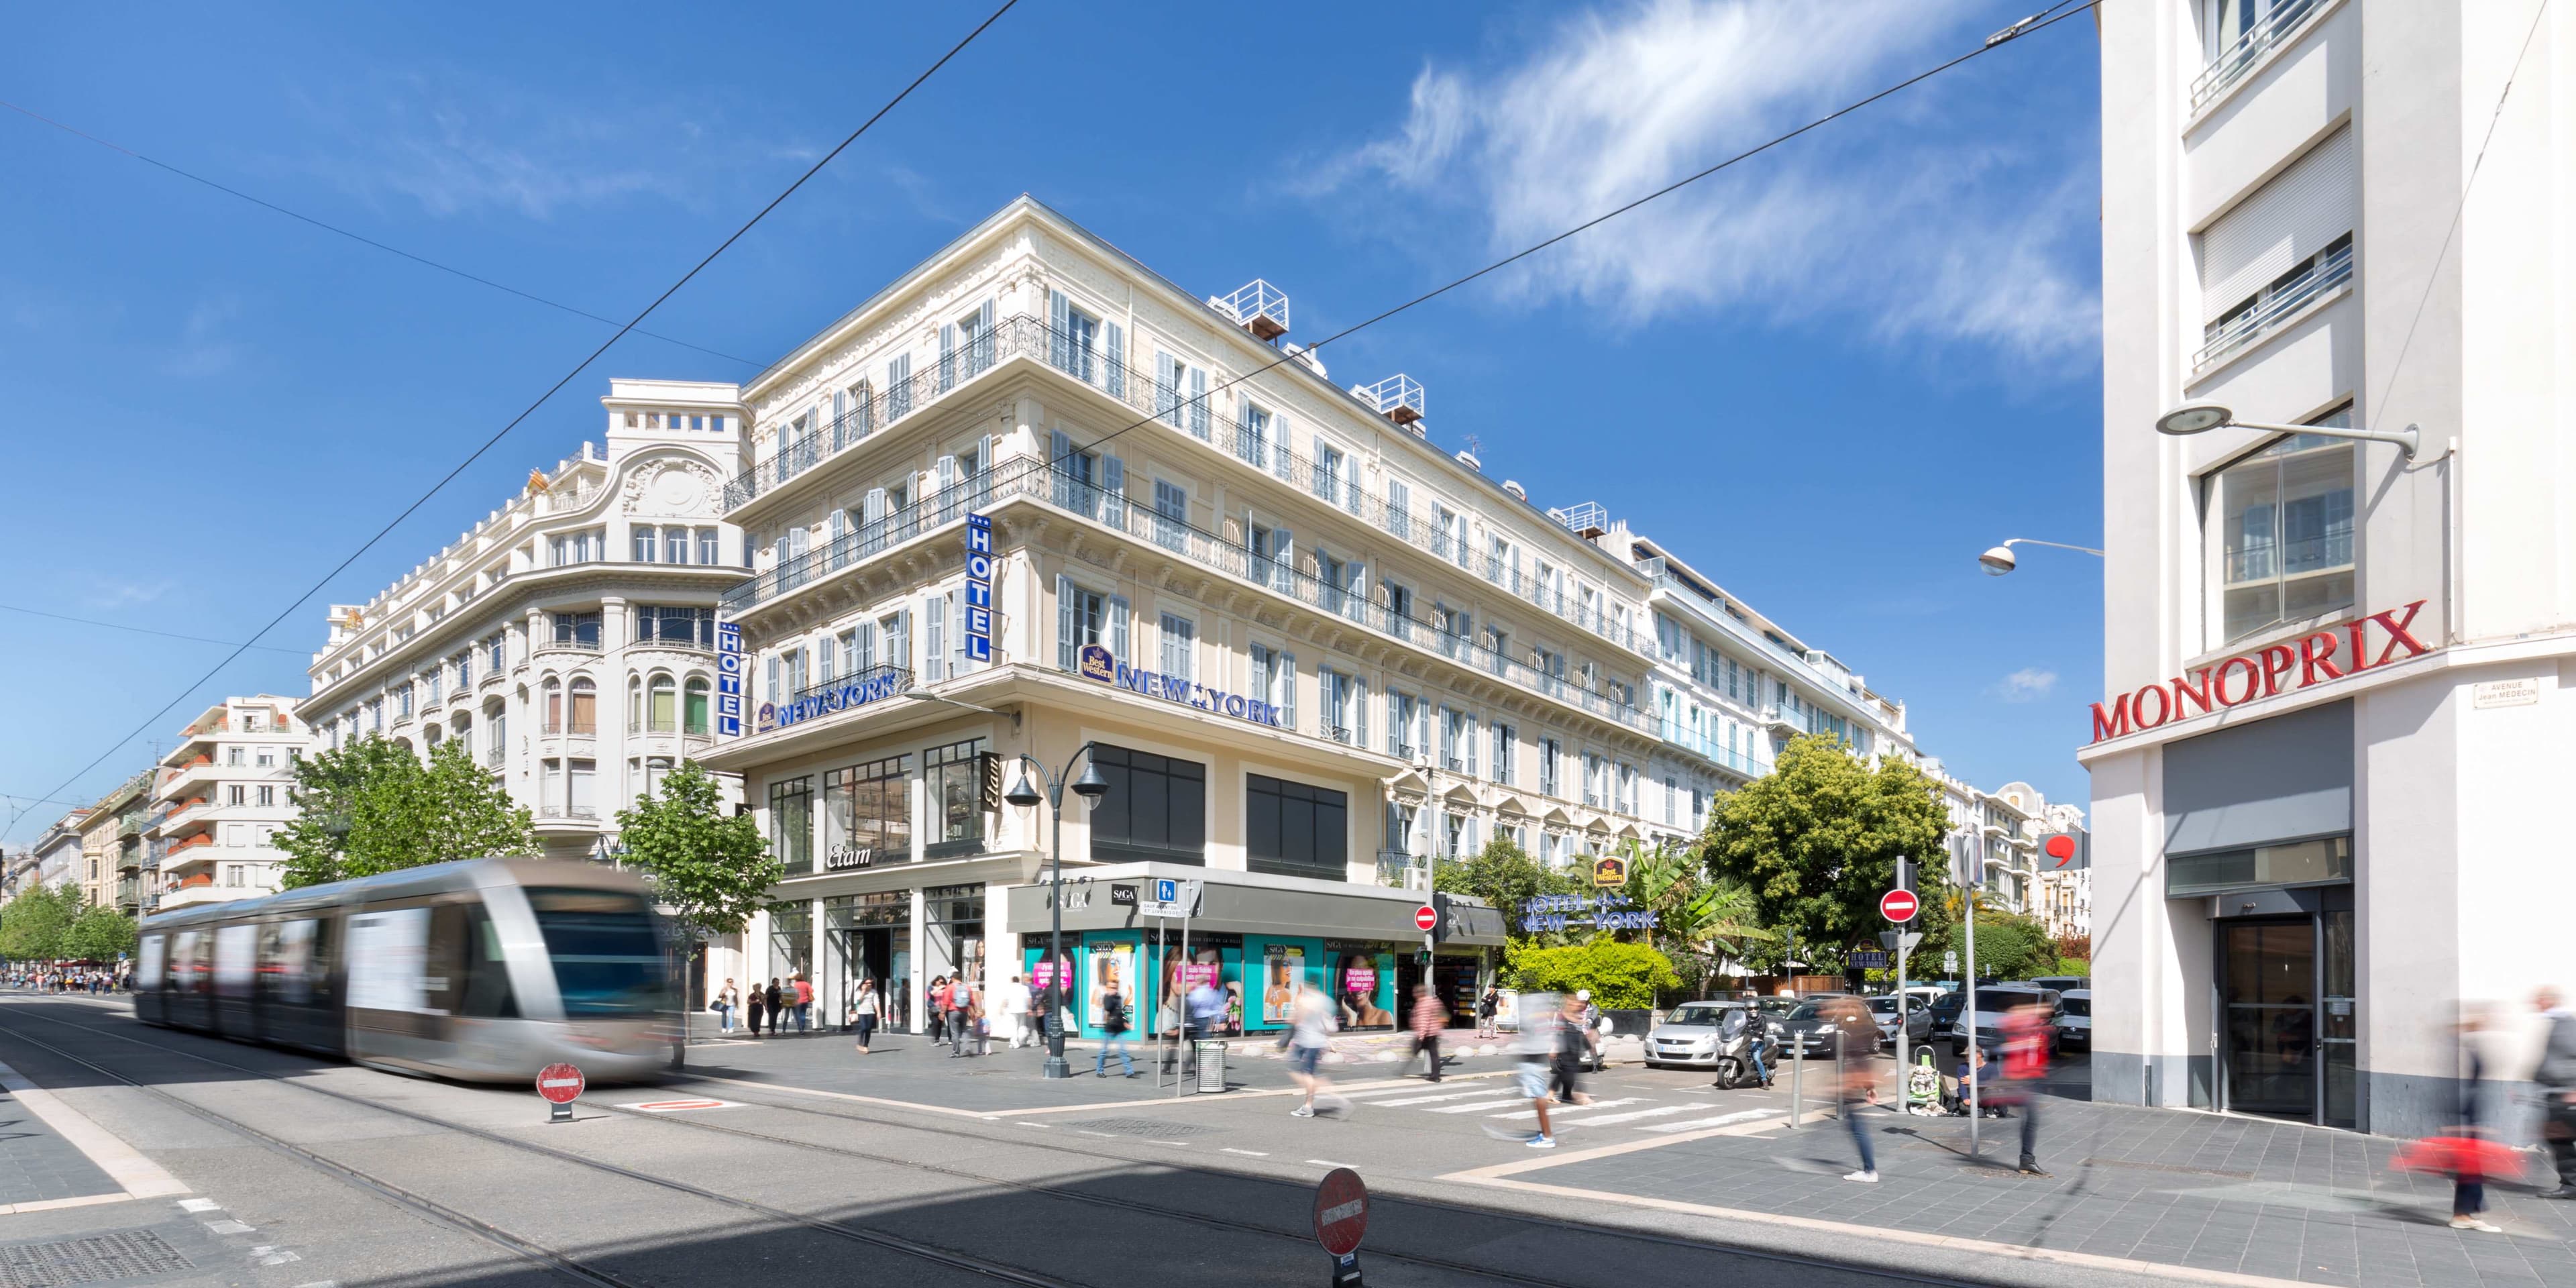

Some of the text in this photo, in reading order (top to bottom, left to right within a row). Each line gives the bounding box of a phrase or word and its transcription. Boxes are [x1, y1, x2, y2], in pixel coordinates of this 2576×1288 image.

[971, 528, 989, 659] HOTEL
[1083, 661, 1112, 682] Western
[1089, 655, 1106, 669] Best
[2089, 600, 2430, 744] MONOPRIX
[721, 633, 739, 735] HOTEL
[1117, 663, 1281, 727] NEW YORK
[2491, 682, 2522, 690] AVENUE
[778, 672, 896, 727] NEW YORK
[985, 757, 998, 808] Etam
[827, 844, 871, 868] Etam
[1597, 874, 1623, 882] Western
[1114, 890, 1134, 900] SAGA
[1517, 894, 1587, 913] HOTEL
[1517, 914, 1567, 932] NEW
[1593, 910, 1660, 930] YORK
